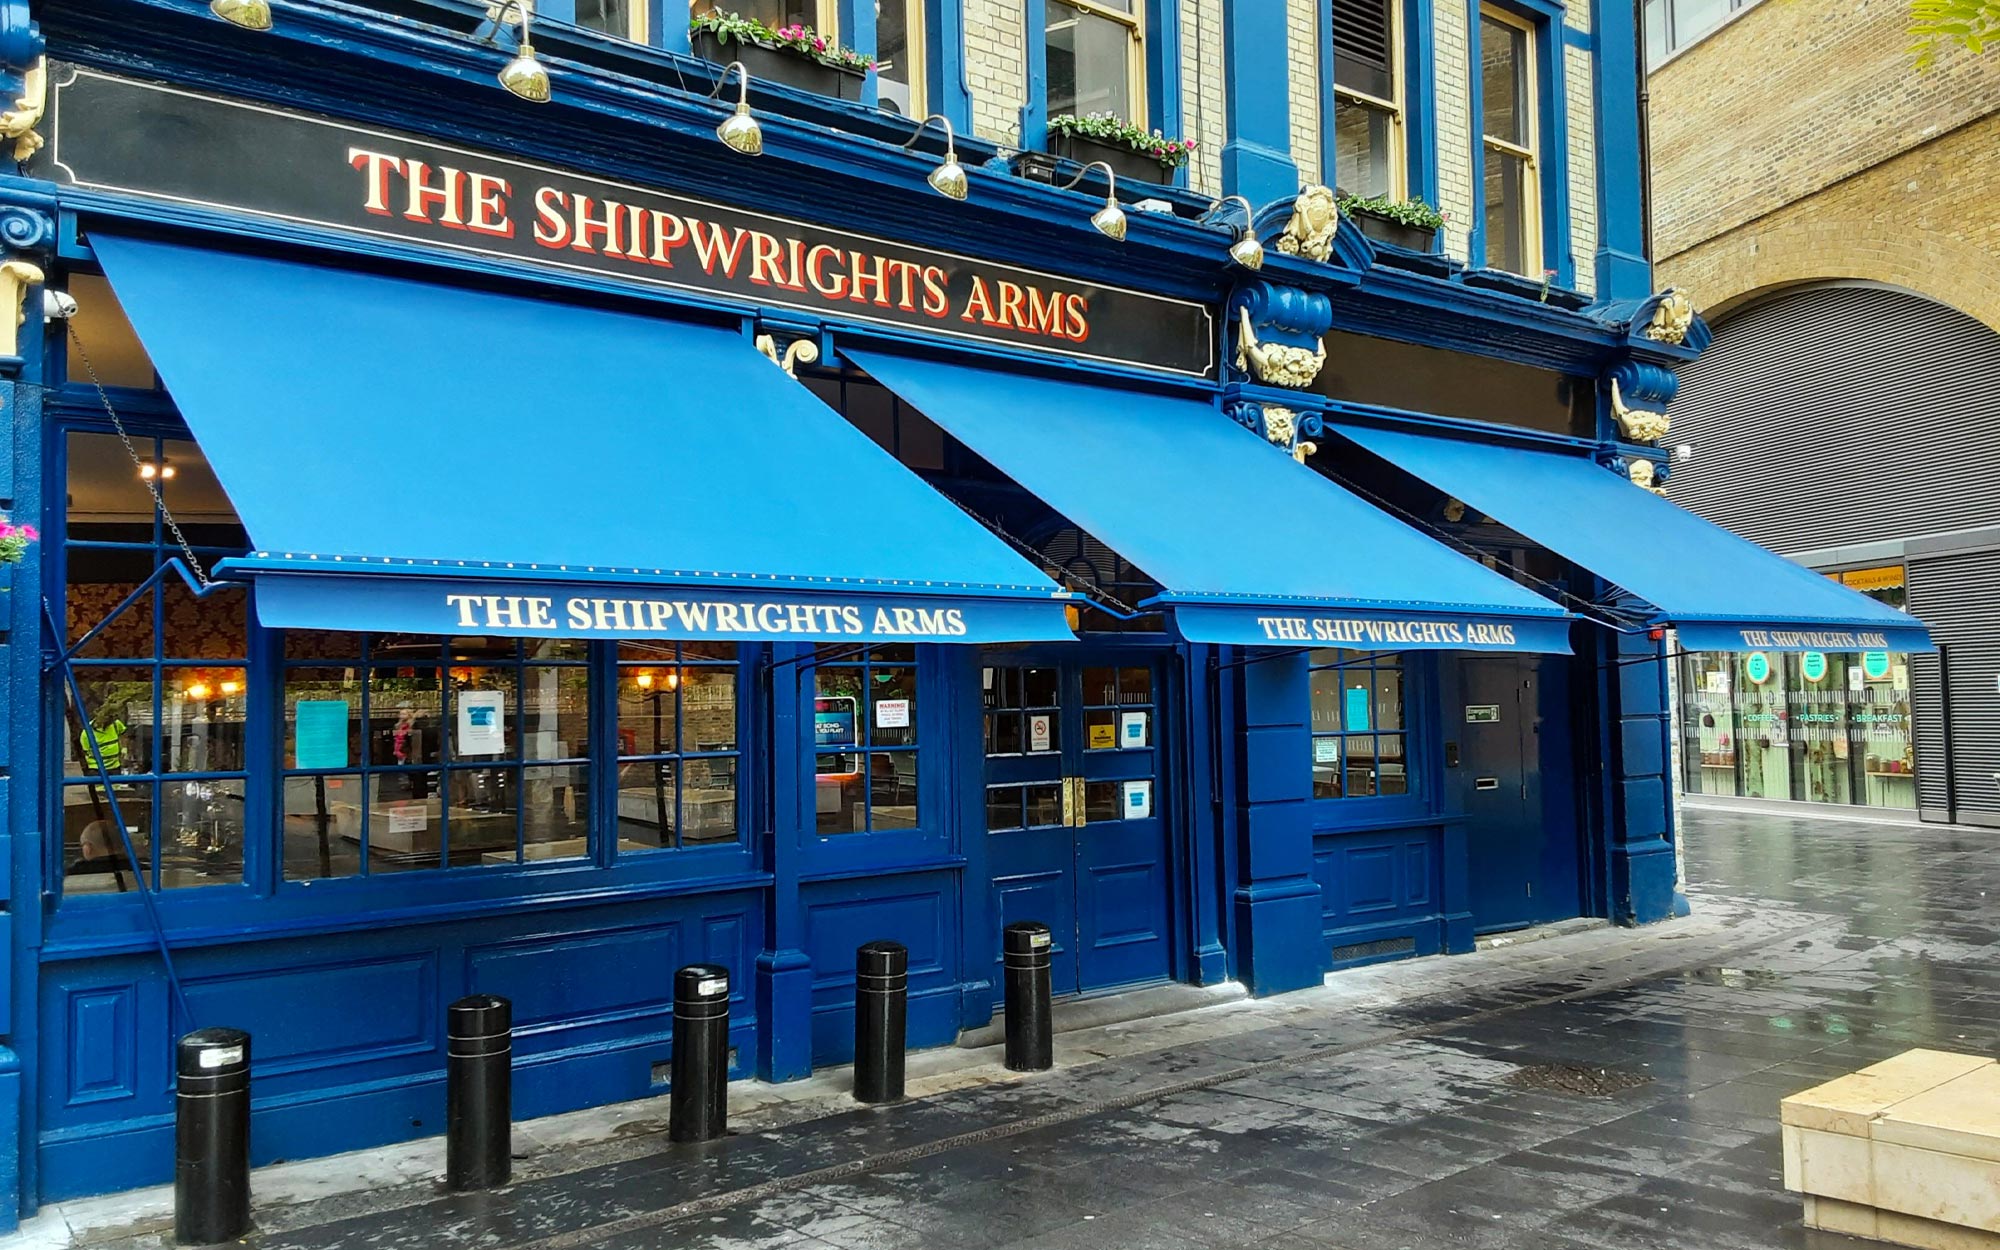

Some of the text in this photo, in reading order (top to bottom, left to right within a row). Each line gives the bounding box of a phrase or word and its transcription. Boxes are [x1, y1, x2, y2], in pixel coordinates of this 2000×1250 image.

[348, 146, 1090, 344] THE SHIPWRIGHTS ARMS
[446, 594, 967, 636] THE SHIPWRIGHTS ARMS
[1257, 617, 1516, 645] THE SHIPWRIGHTS ARMS
[1740, 630, 1889, 648] THE SHIPWRIGHTS ARMS
[1856, 714, 1903, 722] BREAKFAST
